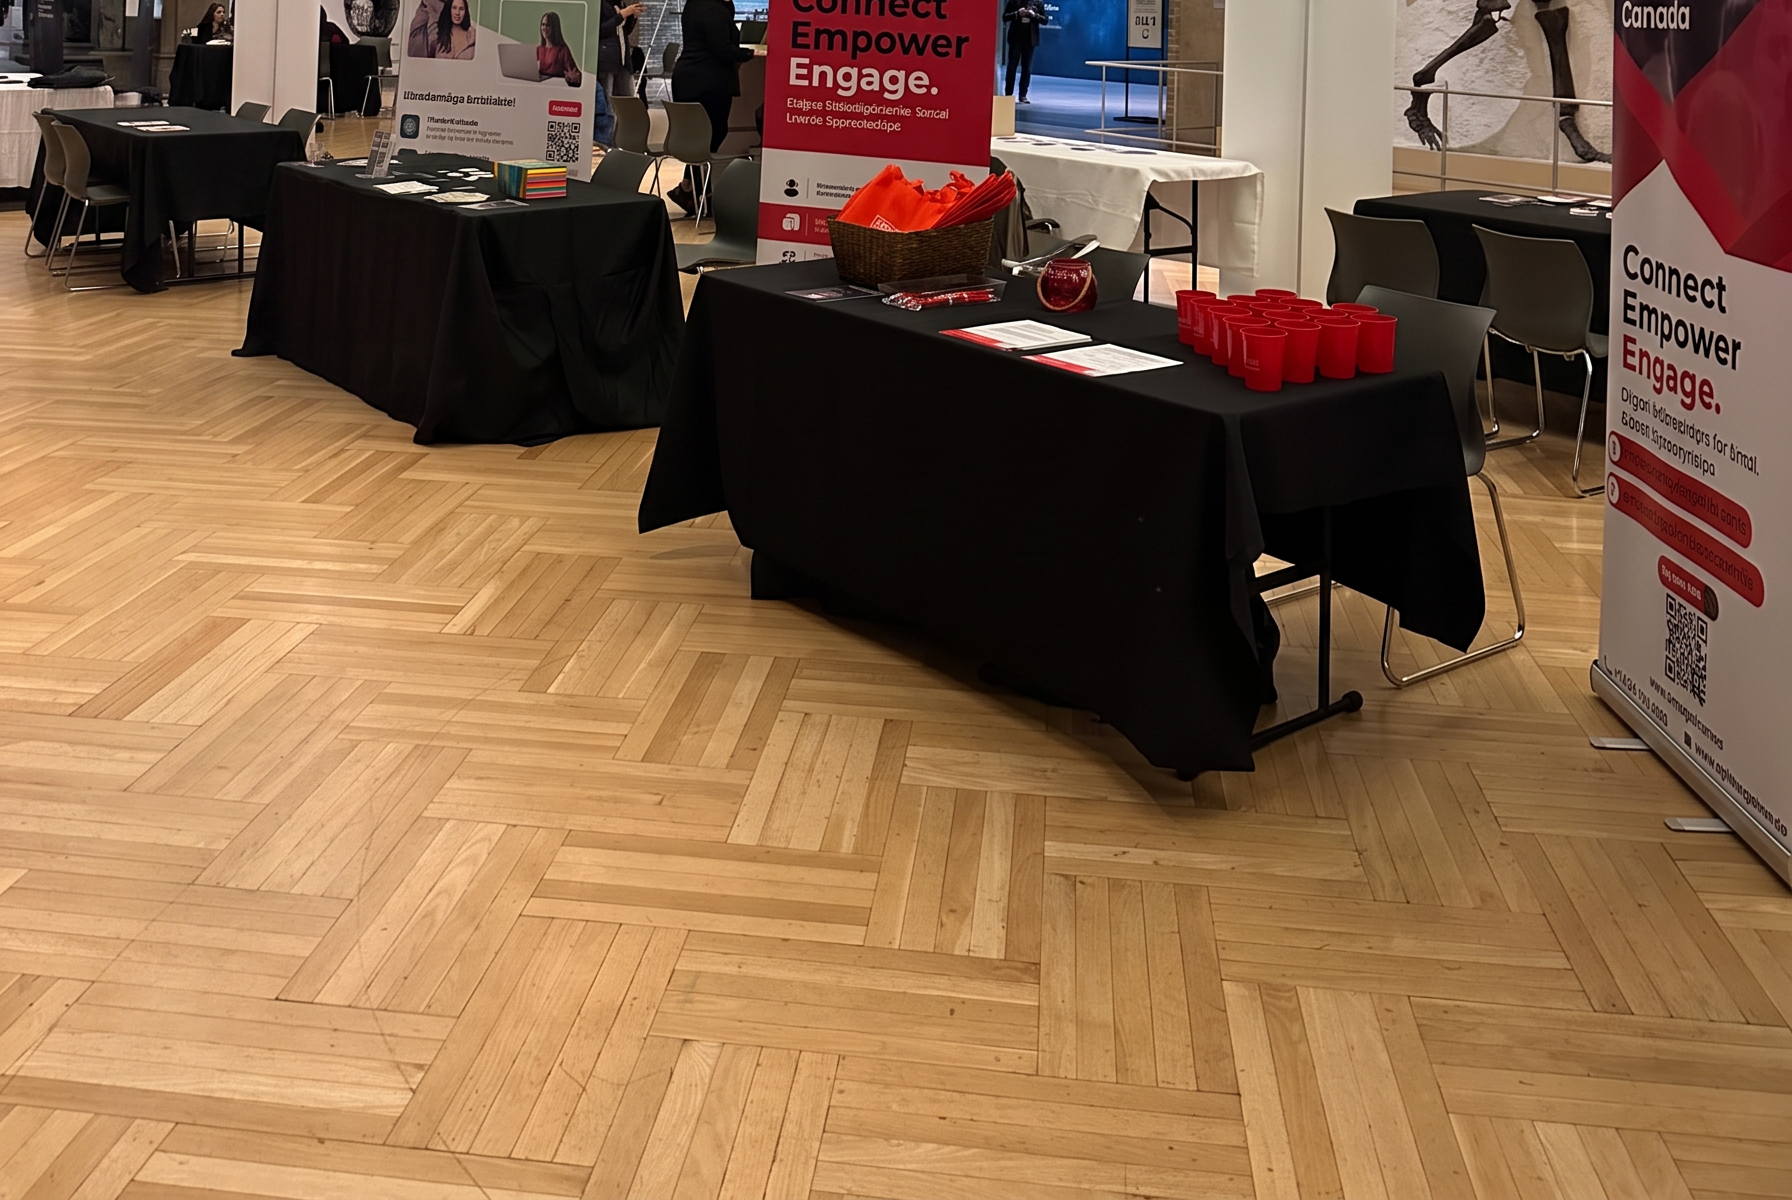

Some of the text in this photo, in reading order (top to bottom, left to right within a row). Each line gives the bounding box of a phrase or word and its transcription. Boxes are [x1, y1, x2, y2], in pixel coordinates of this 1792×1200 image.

[1622, 0, 1690, 30] Canada
[791, 20, 969, 60] Empower
[789, 57, 938, 100] Engage.
[1623, 244, 1726, 314] Connect
[1623, 288, 1741, 371] Empower
[1622, 333, 1721, 415] Engage.
[1713, 433, 1728, 456] for
